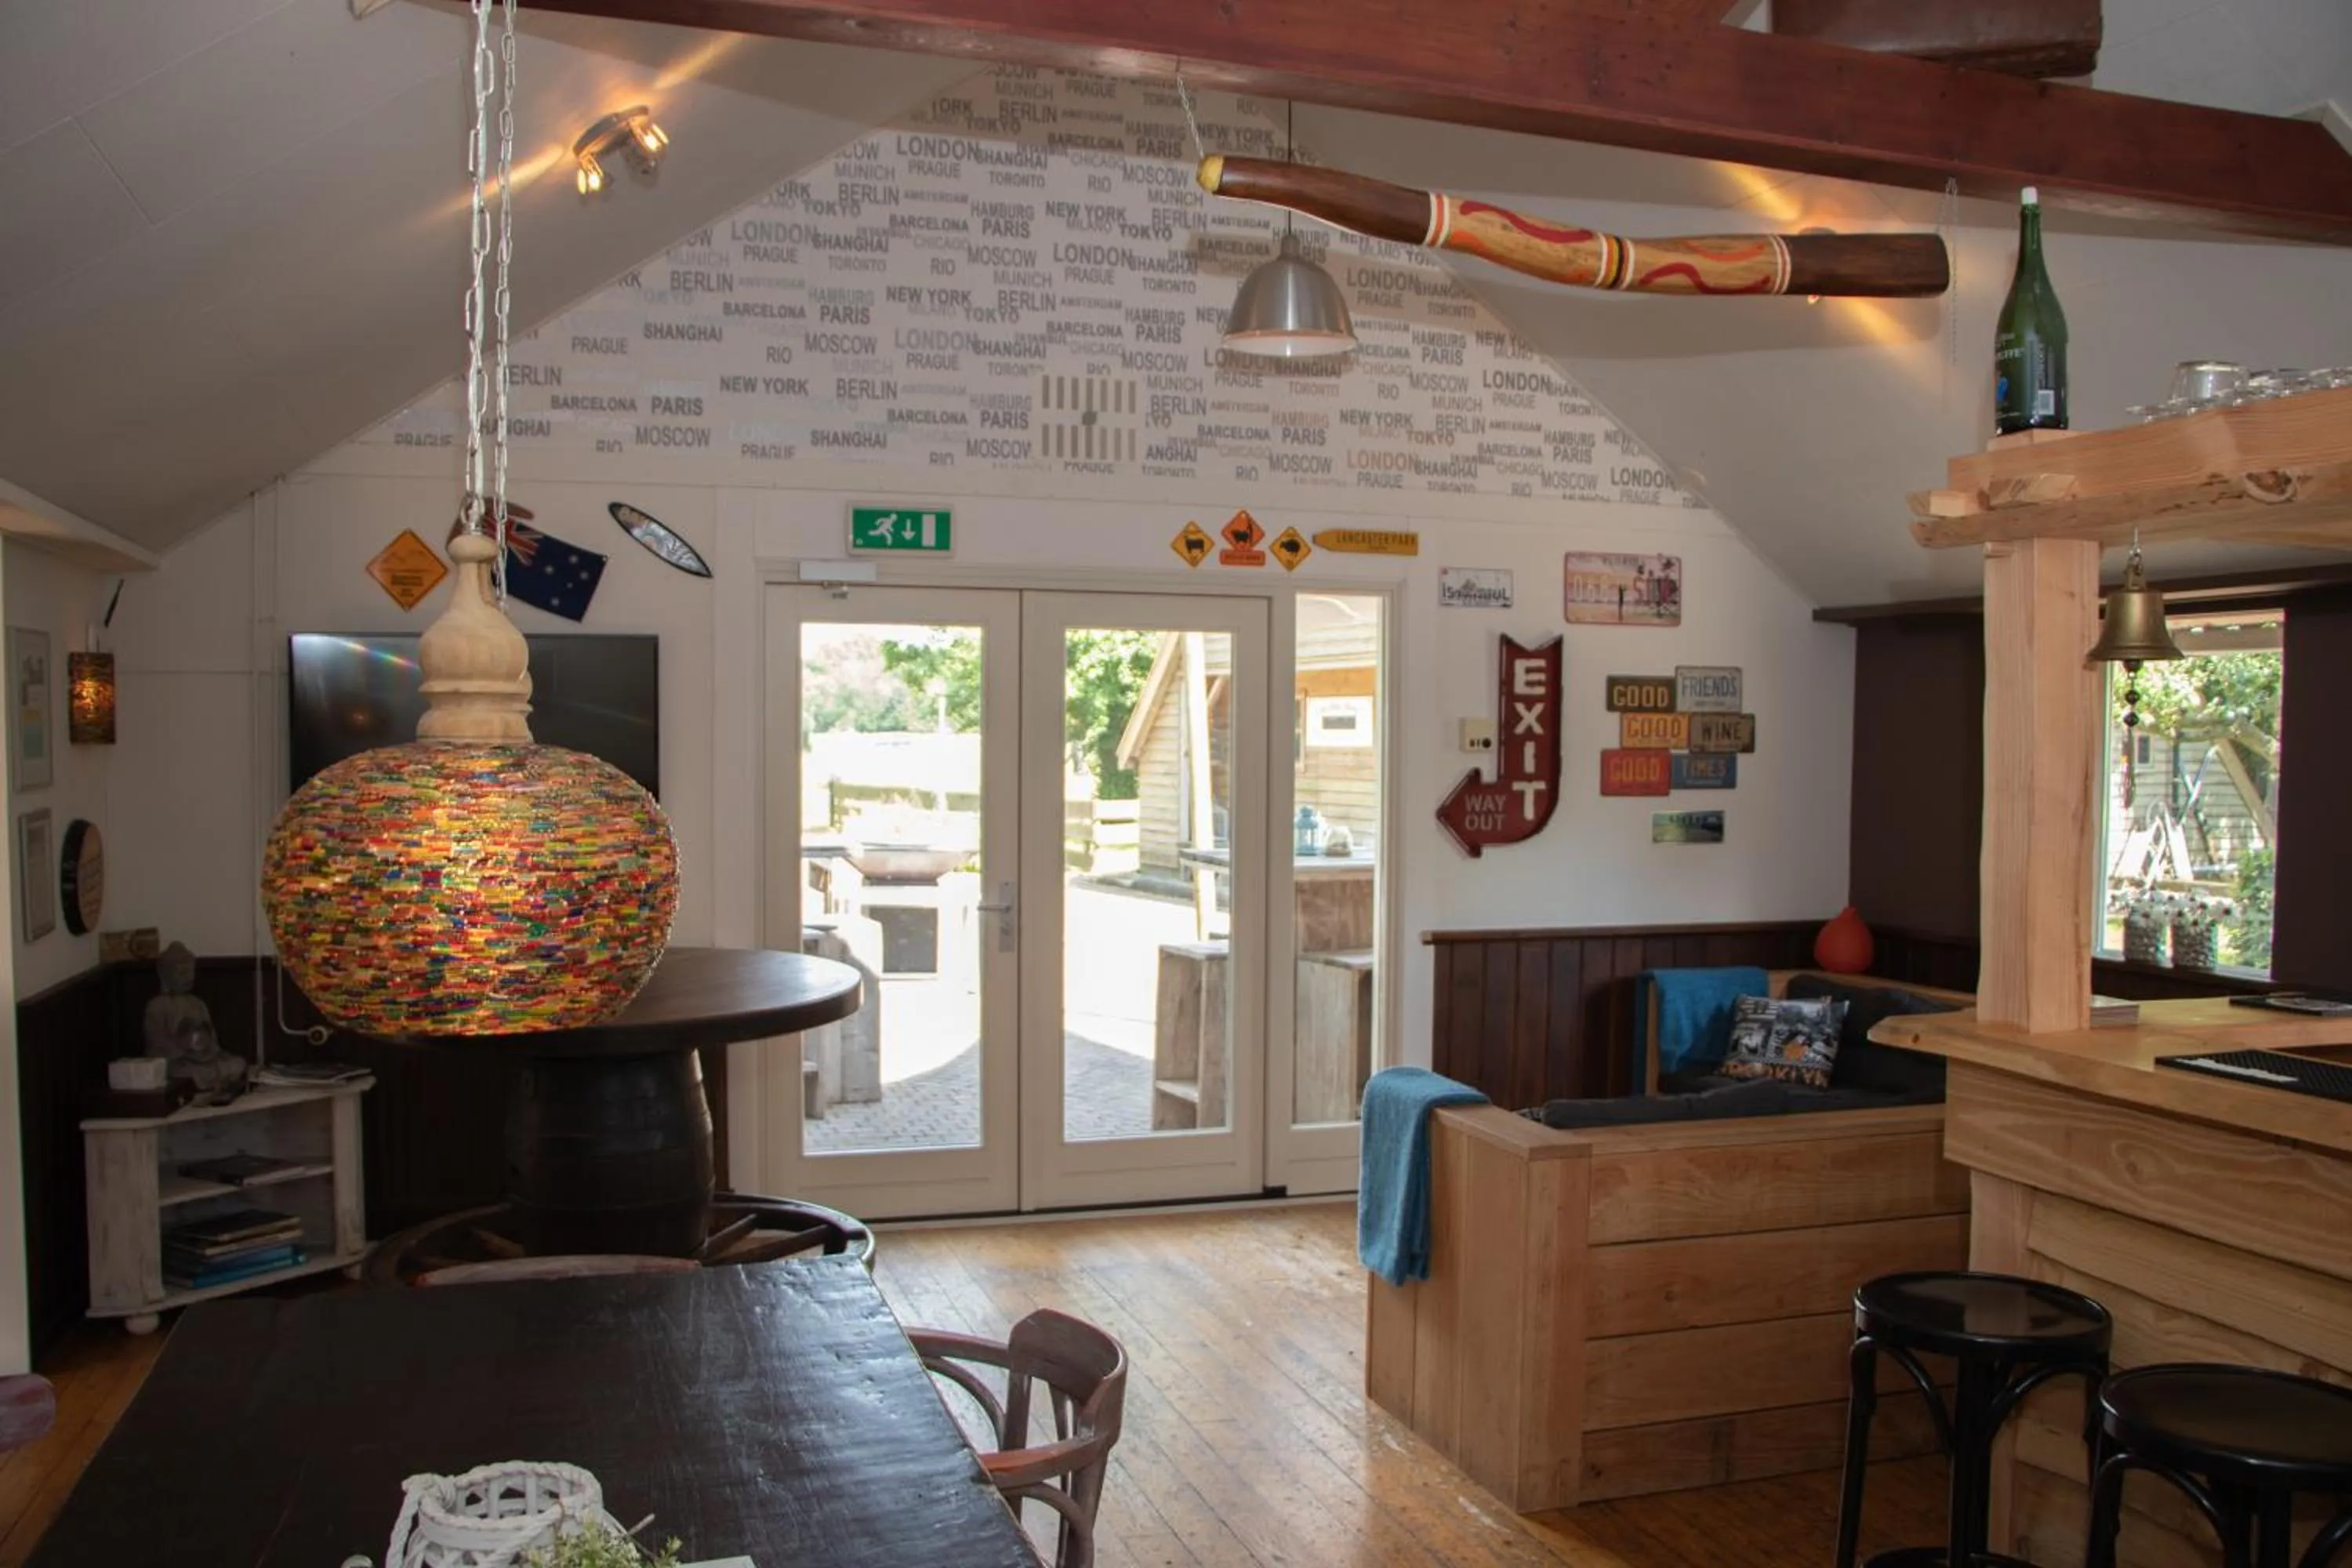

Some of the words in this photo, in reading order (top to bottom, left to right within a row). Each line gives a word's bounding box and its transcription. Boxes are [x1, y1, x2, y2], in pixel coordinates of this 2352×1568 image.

[996, 82, 1054, 100] MUNICH
[1065, 80, 1117, 98] PRAGUE
[999, 98, 1058, 123] BERLIN
[967, 119, 1022, 132] TOKYO
[1125, 120, 1186, 140] HAMBURG
[1196, 122, 1229, 140] NEW
[1232, 127, 1273, 145] YORK
[896, 136, 980, 162] LONDON
[1047, 132, 1123, 151] BARCELONA
[1138, 139, 1181, 157] PARIS
[977, 151, 1047, 169] SHANGHAI
[835, 162, 895, 182] MUNICH
[908, 162, 961, 178] PRAGUE
[989, 171, 1045, 188] TORONTO
[1123, 167, 1189, 188] MOSCOW
[1088, 174, 1111, 193] RIO
[838, 184, 899, 205] BERLIN
[1148, 189, 1203, 207] MUNICH
[804, 200, 861, 218] TOKYO
[971, 201, 1034, 220] HAMBURG
[1045, 201, 1080, 218] NEW
[1084, 204, 1126, 221] YORK
[890, 215, 969, 231] BARCELONA
[982, 219, 1030, 238] PARIS
[1152, 209, 1207, 230] BERLIN
[1211, 216, 1269, 229] AMSTERDAM
[731, 220, 818, 245] LONDON
[1119, 223, 1172, 241] TOKYO
[812, 232, 889, 252] SHANGHAI
[1198, 238, 1270, 256] BARCELONA
[743, 246, 799, 263] PRAGUE
[967, 246, 1036, 267] MOSCOW
[1053, 243, 1132, 267] LONDON
[931, 259, 956, 275] RIO
[1130, 256, 1198, 275] SHANGHAI
[670, 271, 733, 292] BERLIN
[994, 270, 1052, 287] MUNICH
[1065, 267, 1115, 285] PRAGUE
[1347, 268, 1420, 291] LONDON
[1142, 278, 1196, 294] TORONTO
[886, 285, 922, 304] NEW
[926, 289, 971, 307] YORK
[998, 289, 1056, 312] BERLIN
[1357, 290, 1404, 308] PRAGUE
[723, 302, 806, 318] BARCELONA
[820, 307, 870, 325] PARIS
[964, 307, 1019, 324] TOKYO
[1125, 307, 1185, 326] HAMBURG
[643, 322, 723, 342] SHANGHAI
[895, 328, 979, 350] LONDON
[1047, 321, 1123, 338] BARCELONA
[1136, 324, 1181, 343] PARIS
[572, 336, 628, 354] PRAGUE
[804, 334, 877, 354] MOSCOW
[1412, 329, 1466, 350] HAMBURG
[766, 347, 793, 365] RIO
[972, 341, 1047, 359] SHANGHAI
[1422, 349, 1463, 366] PARIS
[906, 354, 960, 371] PRAGUE
[1123, 352, 1188, 372] MOSCOW
[720, 376, 757, 393] NEW
[762, 379, 809, 396] YORK
[837, 379, 898, 399] BERLIN
[1145, 375, 1203, 392] MUNICH
[1215, 372, 1263, 388] PRAGUE
[1411, 373, 1468, 393] MOSCOW
[1483, 370, 1550, 391] LONDON
[1378, 383, 1399, 400] RIO
[1493, 393, 1537, 409] PRAGUE
[552, 396, 637, 412] BARCELONA
[651, 397, 703, 416] PARIS
[1150, 395, 1207, 416] BERLIN
[1432, 395, 1483, 412] MUNICH
[887, 409, 968, 425] BARCELONA
[981, 410, 1029, 430] PARIS
[1340, 409, 1371, 426] NEW
[1374, 412, 1414, 428] YORK
[1436, 412, 1486, 434] BERLIN
[636, 426, 711, 448] MOSCOW
[811, 430, 887, 449] SHANGHAI
[1197, 424, 1271, 441] BARCELONA
[1282, 427, 1327, 446] PARIS
[1406, 430, 1455, 446] TOKYO
[1544, 431, 1595, 448] HAMBURG
[741, 444, 796, 460] PRAGUE
[1346, 449, 1418, 470] LONDON
[1478, 443, 1541, 457] BARCELONA
[1553, 448, 1592, 464] PARIS
[1269, 453, 1334, 474] MOSCOW
[1414, 459, 1478, 479] SHANGHAI
[1235, 466, 1259, 481] RIO
[1357, 472, 1403, 488] PRAGUE
[1540, 471, 1599, 490] MOSCOW
[1611, 467, 1676, 491] LONDON
[1613, 685, 1670, 708] GOOD
[1681, 675, 1737, 698] FRIENDS
[1626, 718, 1682, 739] GOOD
[1701, 720, 1743, 741] WINE
[1512, 658, 1547, 822] EXIT
[1610, 759, 1661, 782] GOOD
[1465, 793, 1506, 812] WAY
[1465, 814, 1505, 831] OUT
